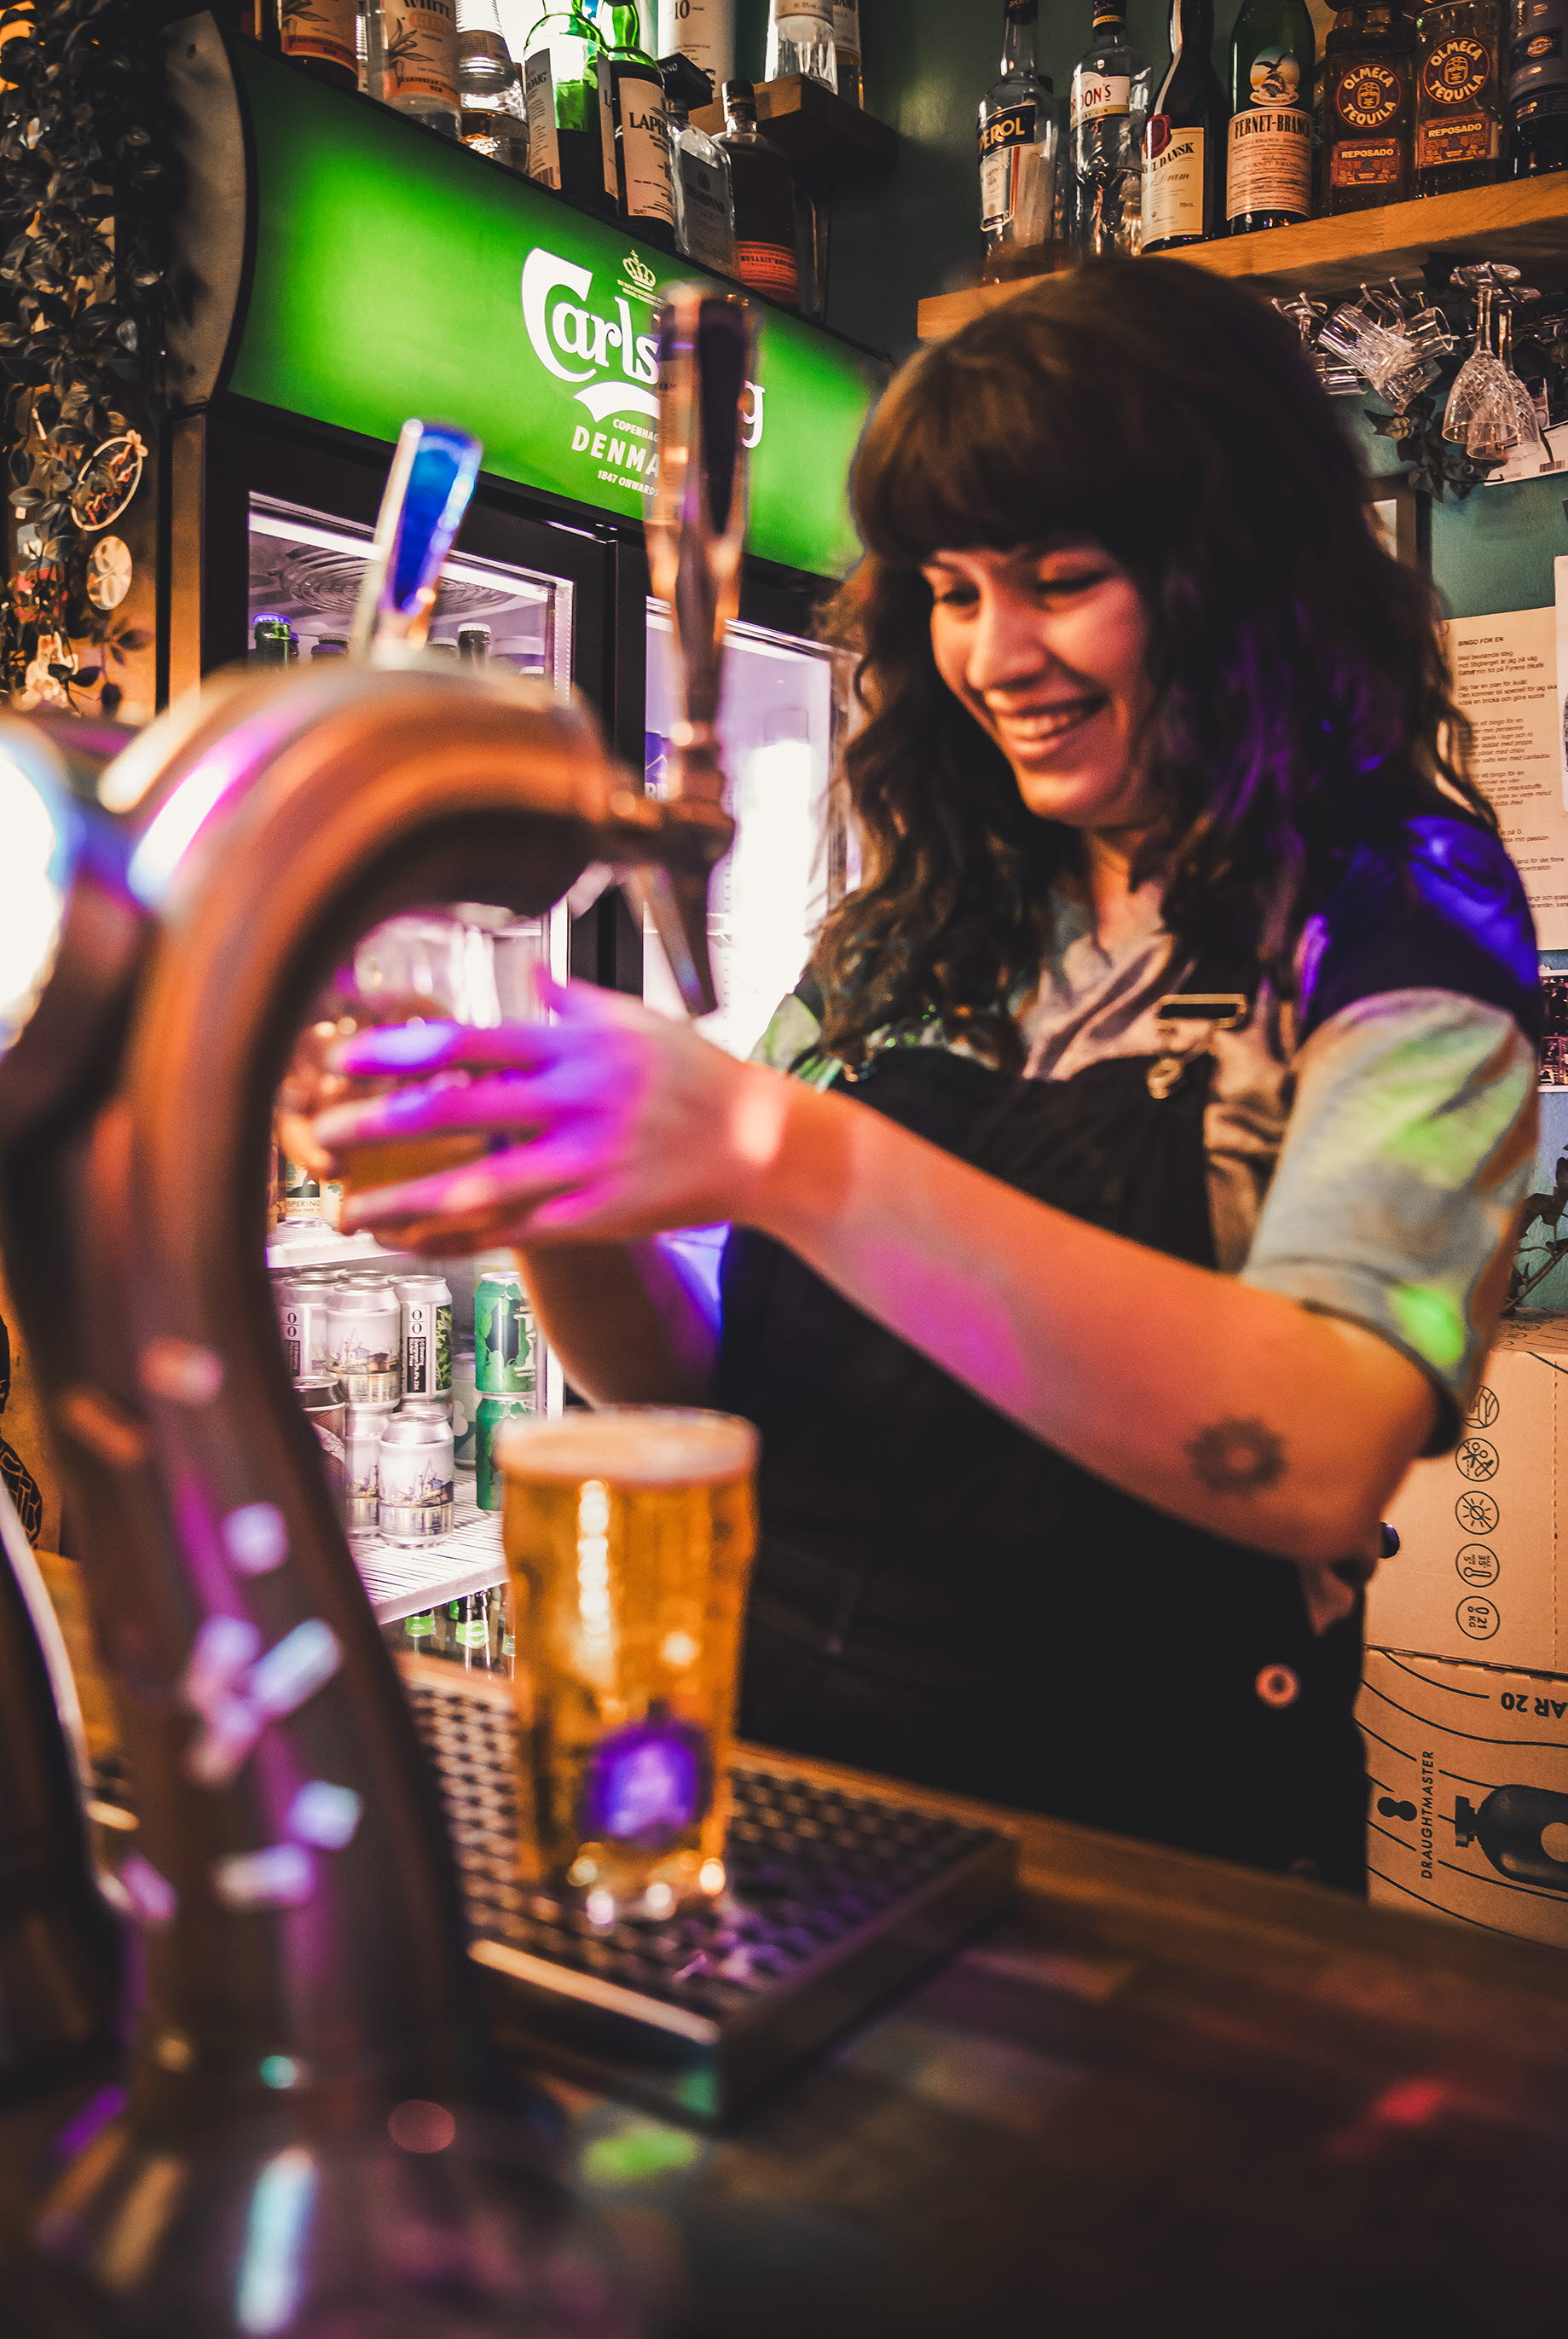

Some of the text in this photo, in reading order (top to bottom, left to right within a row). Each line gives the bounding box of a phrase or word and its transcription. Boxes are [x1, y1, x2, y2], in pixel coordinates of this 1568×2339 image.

[674, 1, 690, 20] 10
[1430, 40, 1483, 67] OLMECA
[1343, 67, 1394, 90] OLMECA
[1430, 74, 1485, 101] TEQUILA
[1343, 101, 1396, 125] TEQUILA
[1428, 123, 1483, 138] REPOSADO
[1341, 148, 1394, 159] REPOSADO
[521, 246, 766, 449] Carlsg
[613, 419, 659, 443] COPENHAG
[571, 425, 660, 478] DENMA
[598, 470, 618, 483] 1847
[1468, 1615, 1477, 1628] KG
[1477, 1616, 1488, 1630] 21
[1501, 1692, 1529, 1713] 20
[1420, 1751, 1434, 1879] DRAUGHTMASTER
